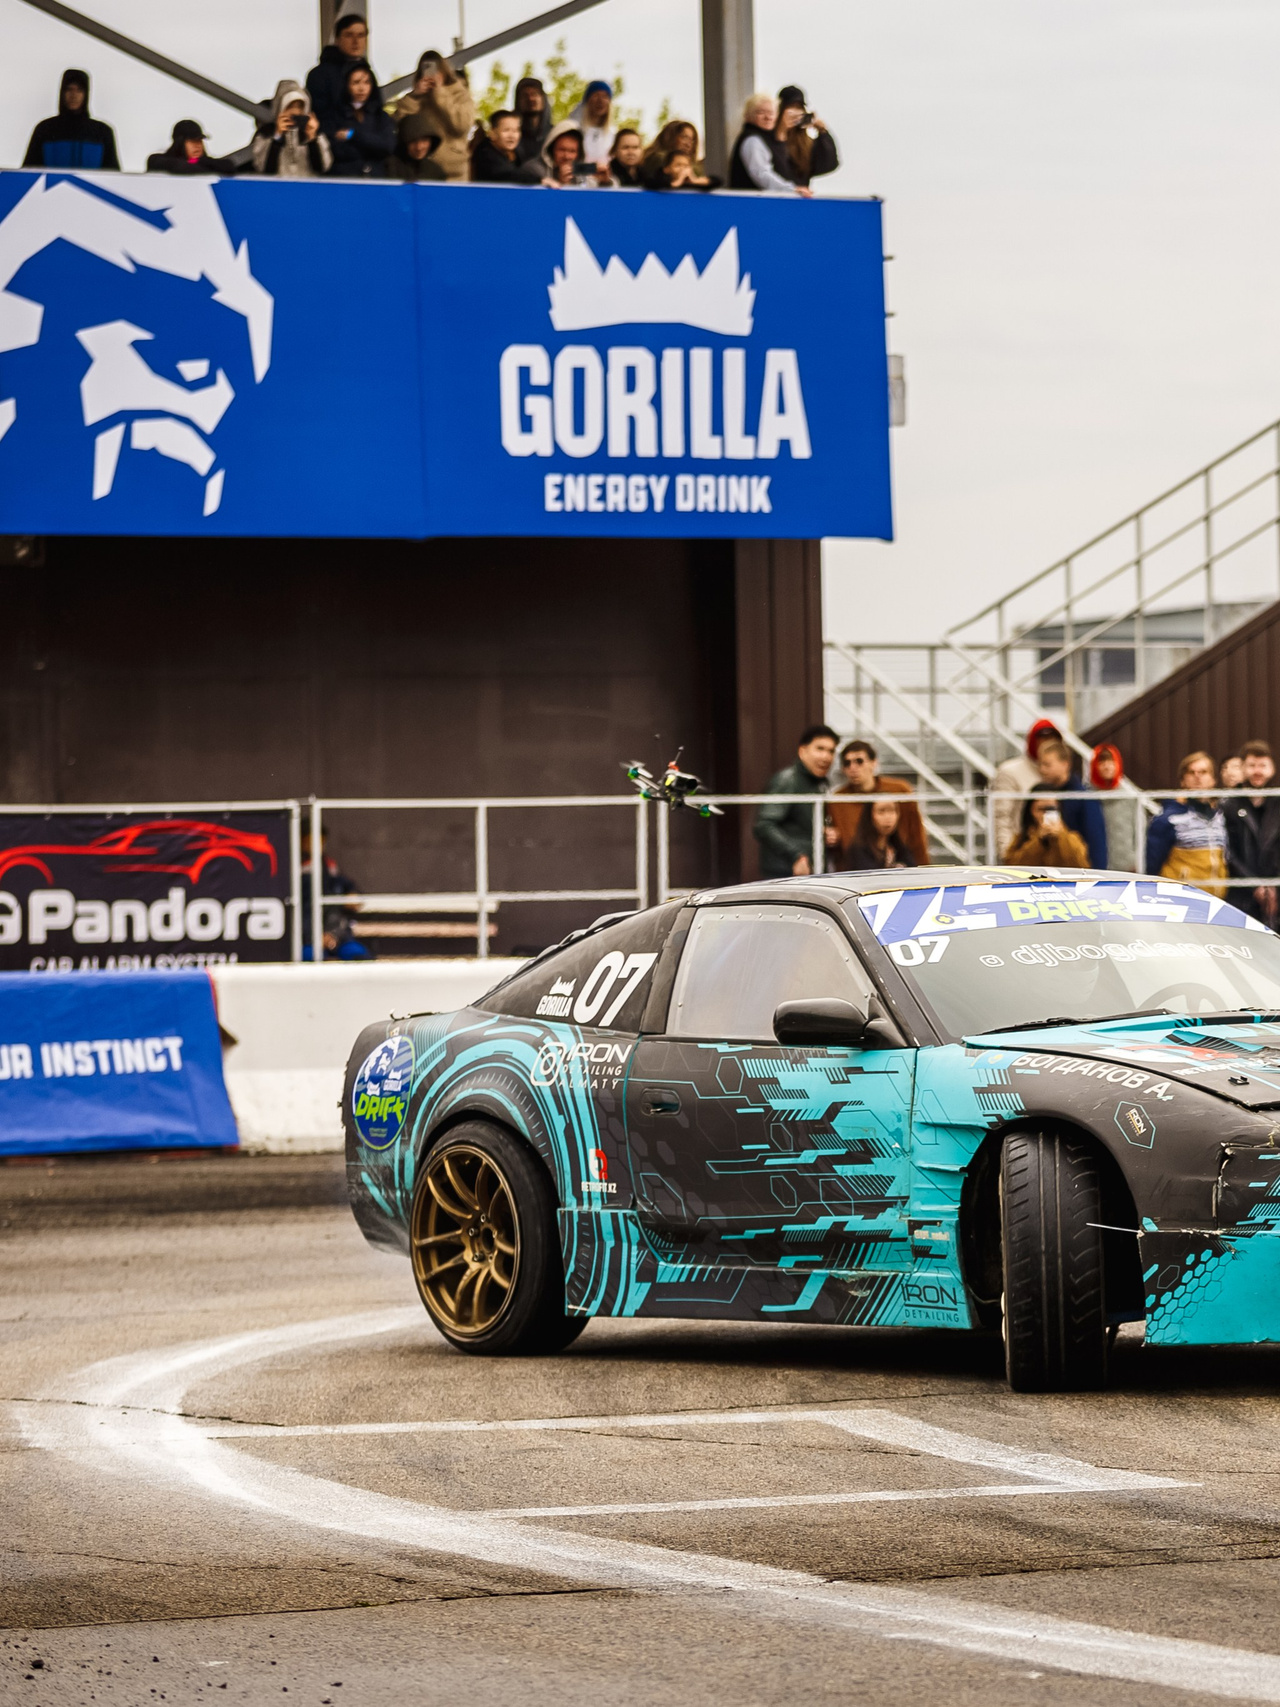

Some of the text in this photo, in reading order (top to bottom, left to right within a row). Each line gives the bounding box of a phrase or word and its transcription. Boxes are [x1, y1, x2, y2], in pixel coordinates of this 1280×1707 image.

[499, 344, 812, 460] GORILLA
[544, 473, 773, 514] ENERGY DRINK
[28, 887, 285, 944] Pandora
[888, 935, 951, 967] 07
[573, 951, 659, 1027] 07
[535, 995, 574, 1017] GORILLA
[41, 1037, 183, 1078] INSTINCT
[566, 1043, 632, 1064] IRON
[558, 1078, 620, 1090] ALMATY
[562, 1064, 623, 1077] DETAILING
[1011, 1053, 1151, 1089] БОГДАНОВ
[901, 1283, 958, 1306] IRON
[904, 1308, 960, 1323] DETAILING
